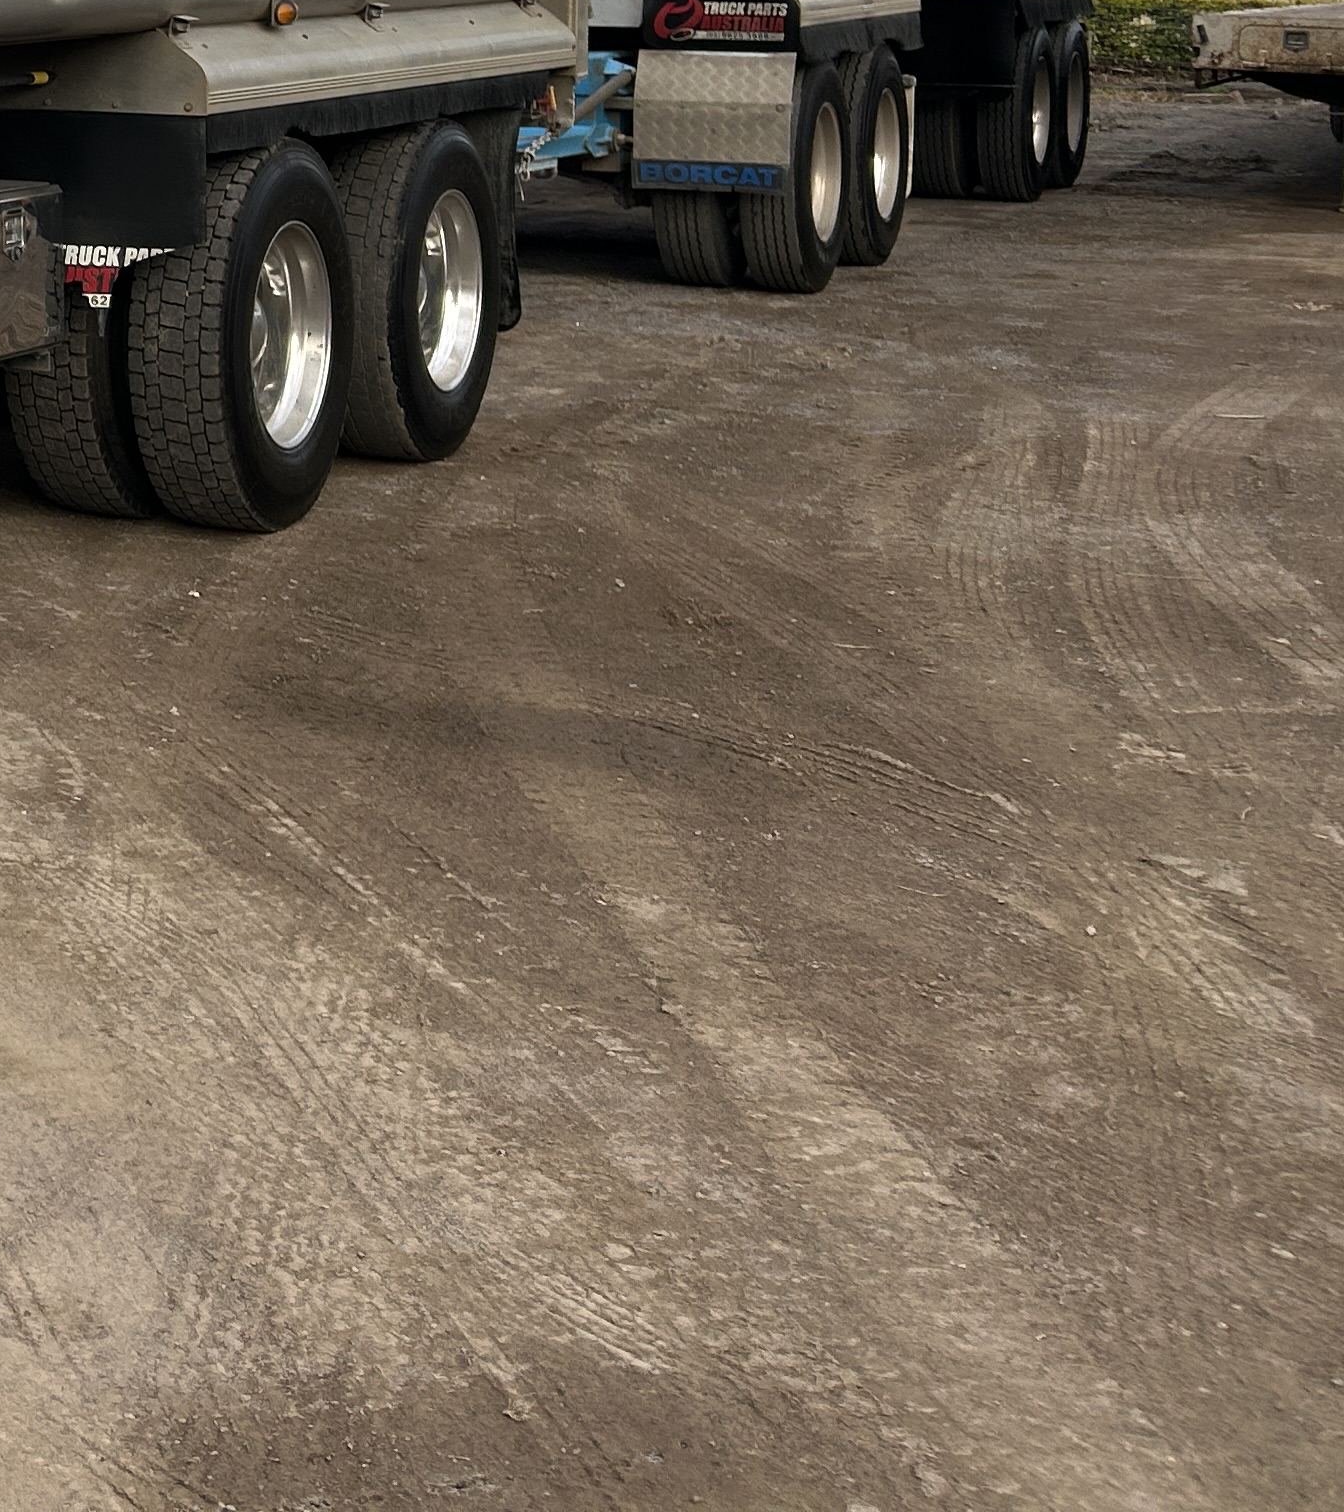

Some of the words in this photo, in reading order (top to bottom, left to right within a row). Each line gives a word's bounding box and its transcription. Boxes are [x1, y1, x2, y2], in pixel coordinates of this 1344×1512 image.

[703, 1, 746, 16] TRUCK
[747, 2, 789, 17] PARTS
[700, 14, 785, 31] AUSTRALIA
[639, 162, 779, 187] BORCAT
